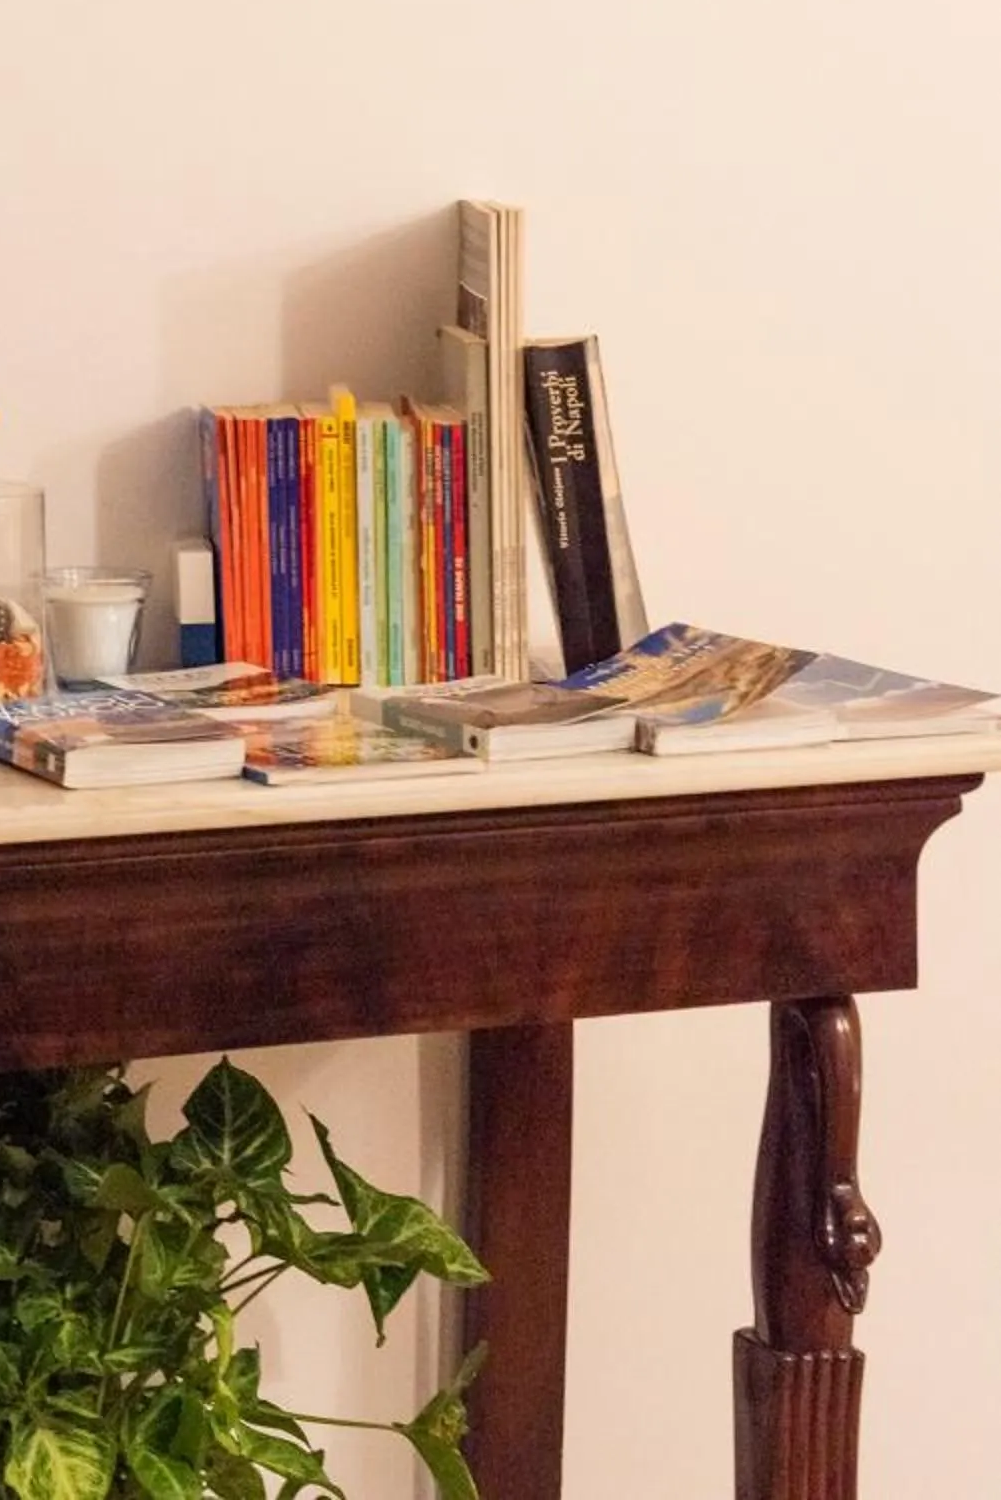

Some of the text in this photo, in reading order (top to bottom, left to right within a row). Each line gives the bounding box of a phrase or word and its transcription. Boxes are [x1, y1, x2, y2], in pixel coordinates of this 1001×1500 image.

[541, 370, 568, 464] I Proverbi
[560, 376, 585, 461] di Napoli
